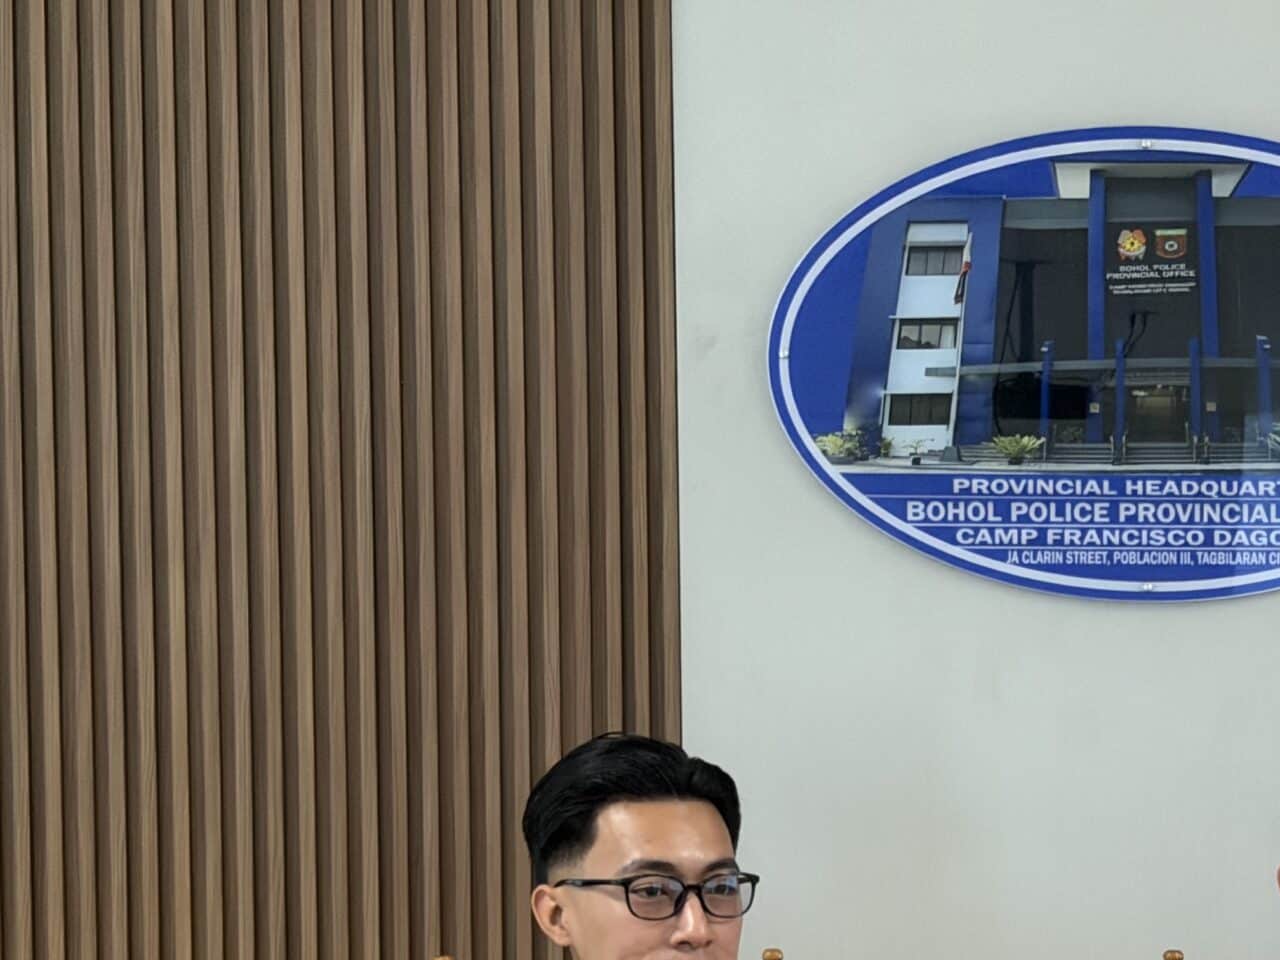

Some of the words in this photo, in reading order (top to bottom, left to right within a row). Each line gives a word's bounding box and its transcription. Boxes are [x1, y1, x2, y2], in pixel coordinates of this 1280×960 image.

[952, 478, 1118, 495] PROVINCIAL
[906, 500, 1002, 522] BOHOL
[1010, 501, 1111, 523] POLICE
[955, 528, 1039, 545] CAMP
[1046, 529, 1205, 547] FRANCISCO
[1007, 551, 1020, 565] JA
[1022, 551, 1064, 564] CLARIN
[1065, 551, 1112, 566] STREET,
[1113, 551, 1179, 565] POBLACION
[1196, 551, 1267, 565] TAGBILARAN
